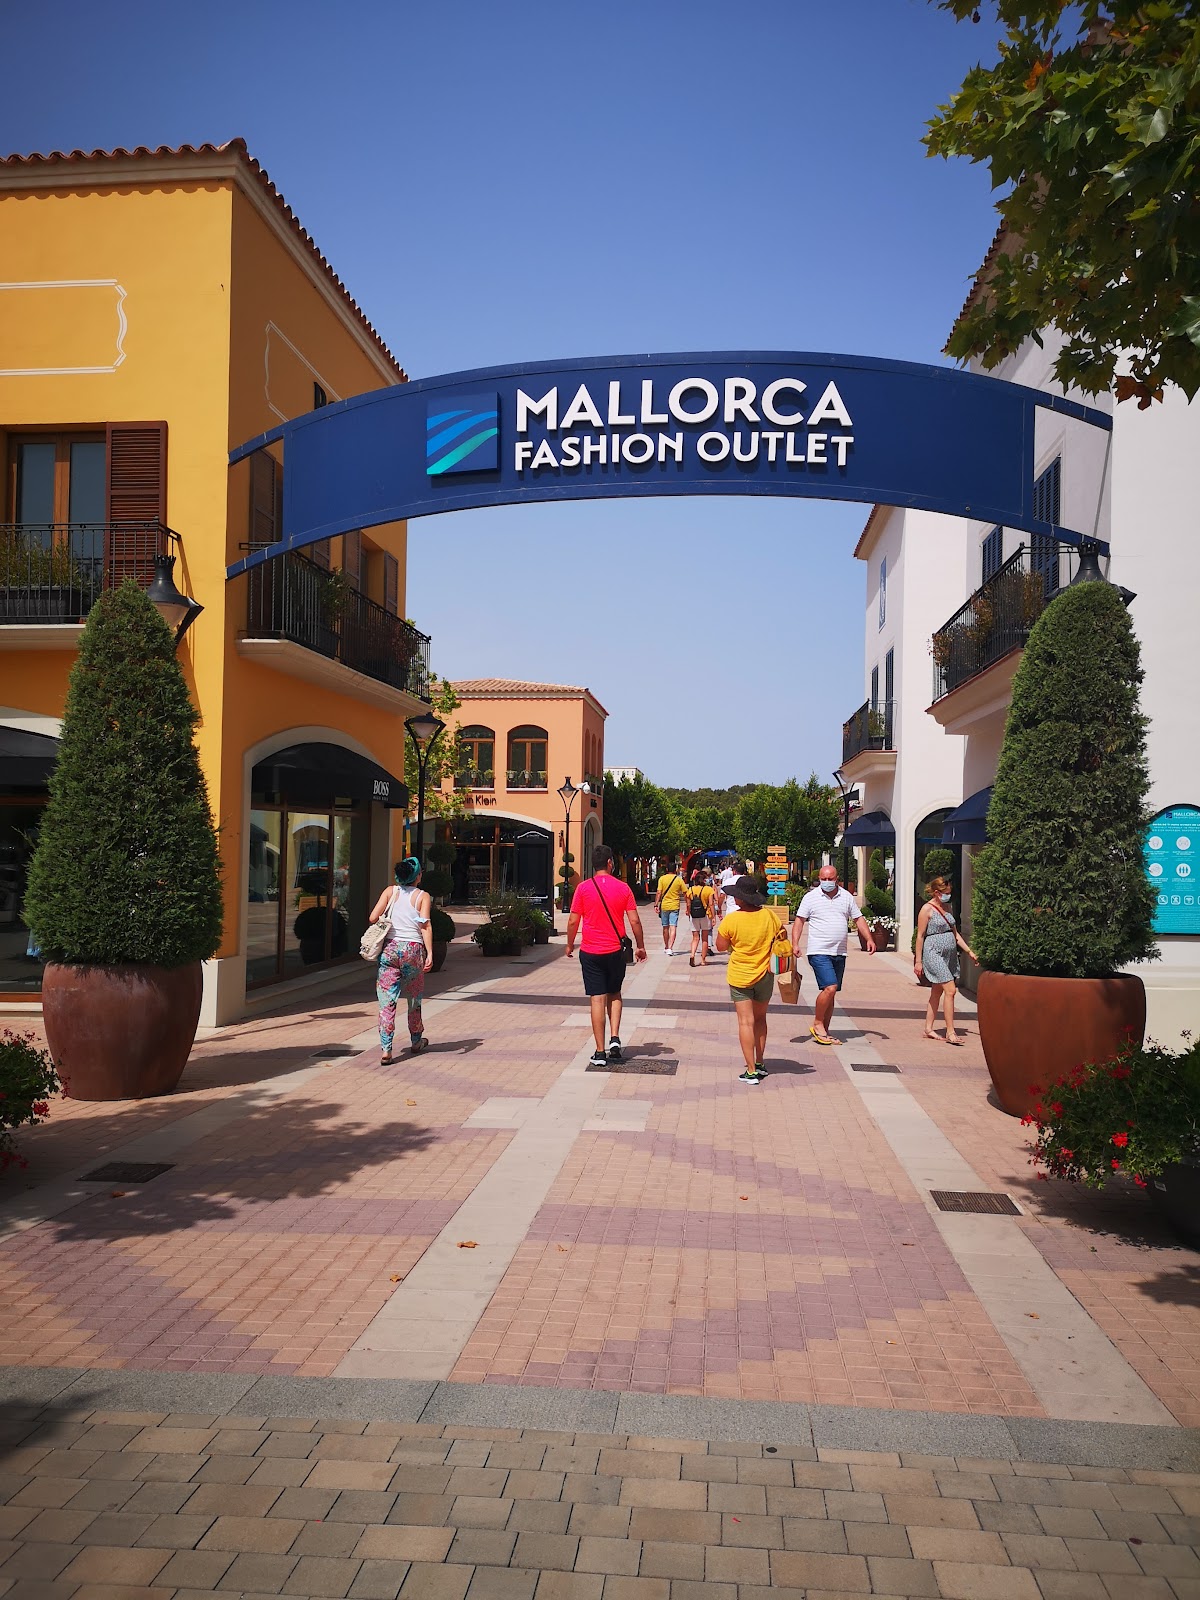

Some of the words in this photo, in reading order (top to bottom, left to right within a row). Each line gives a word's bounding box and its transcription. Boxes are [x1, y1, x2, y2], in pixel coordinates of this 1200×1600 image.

[516, 377, 853, 432] MALLORCA
[515, 432, 684, 471] FASHION
[696, 431, 854, 466] OUTLET
[373, 780, 390, 796] BOSS
[475, 795, 497, 806] Klein
